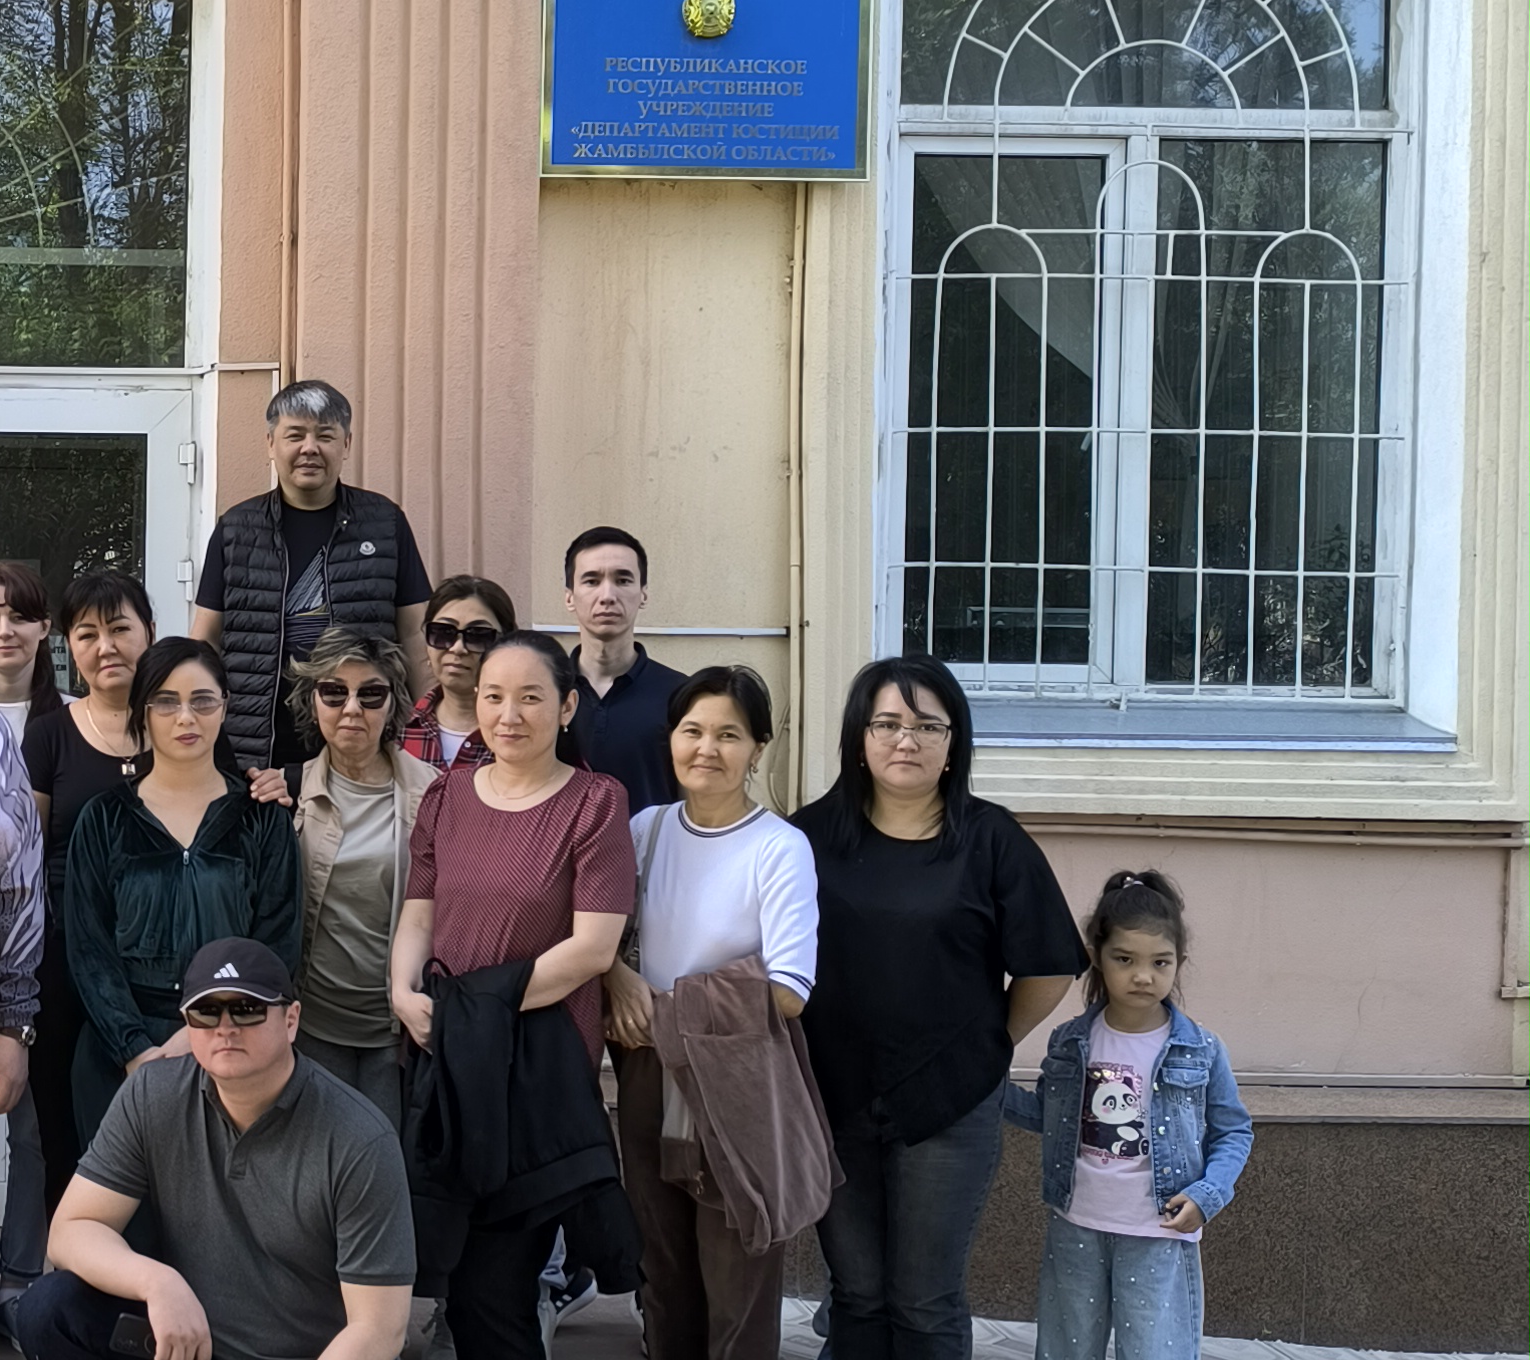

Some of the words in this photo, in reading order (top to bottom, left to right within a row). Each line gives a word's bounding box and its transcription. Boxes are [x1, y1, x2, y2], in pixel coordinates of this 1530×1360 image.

[604, 56, 808, 76] РЕСПУБЛИКАНСКОЕ
[607, 78, 804, 98] ГОСУДАРСТВЕННОЕ
[638, 100, 775, 120] УЧРЕЖДЕНИЕ
[571, 121, 728, 140] «ДЕПАРТАМЕНТ
[732, 123, 840, 143] ЮСТИЦИИ
[572, 141, 727, 160] ЖАМБЫЛСКОЙ
[730, 144, 836, 162] ОБЛАСТИ»
